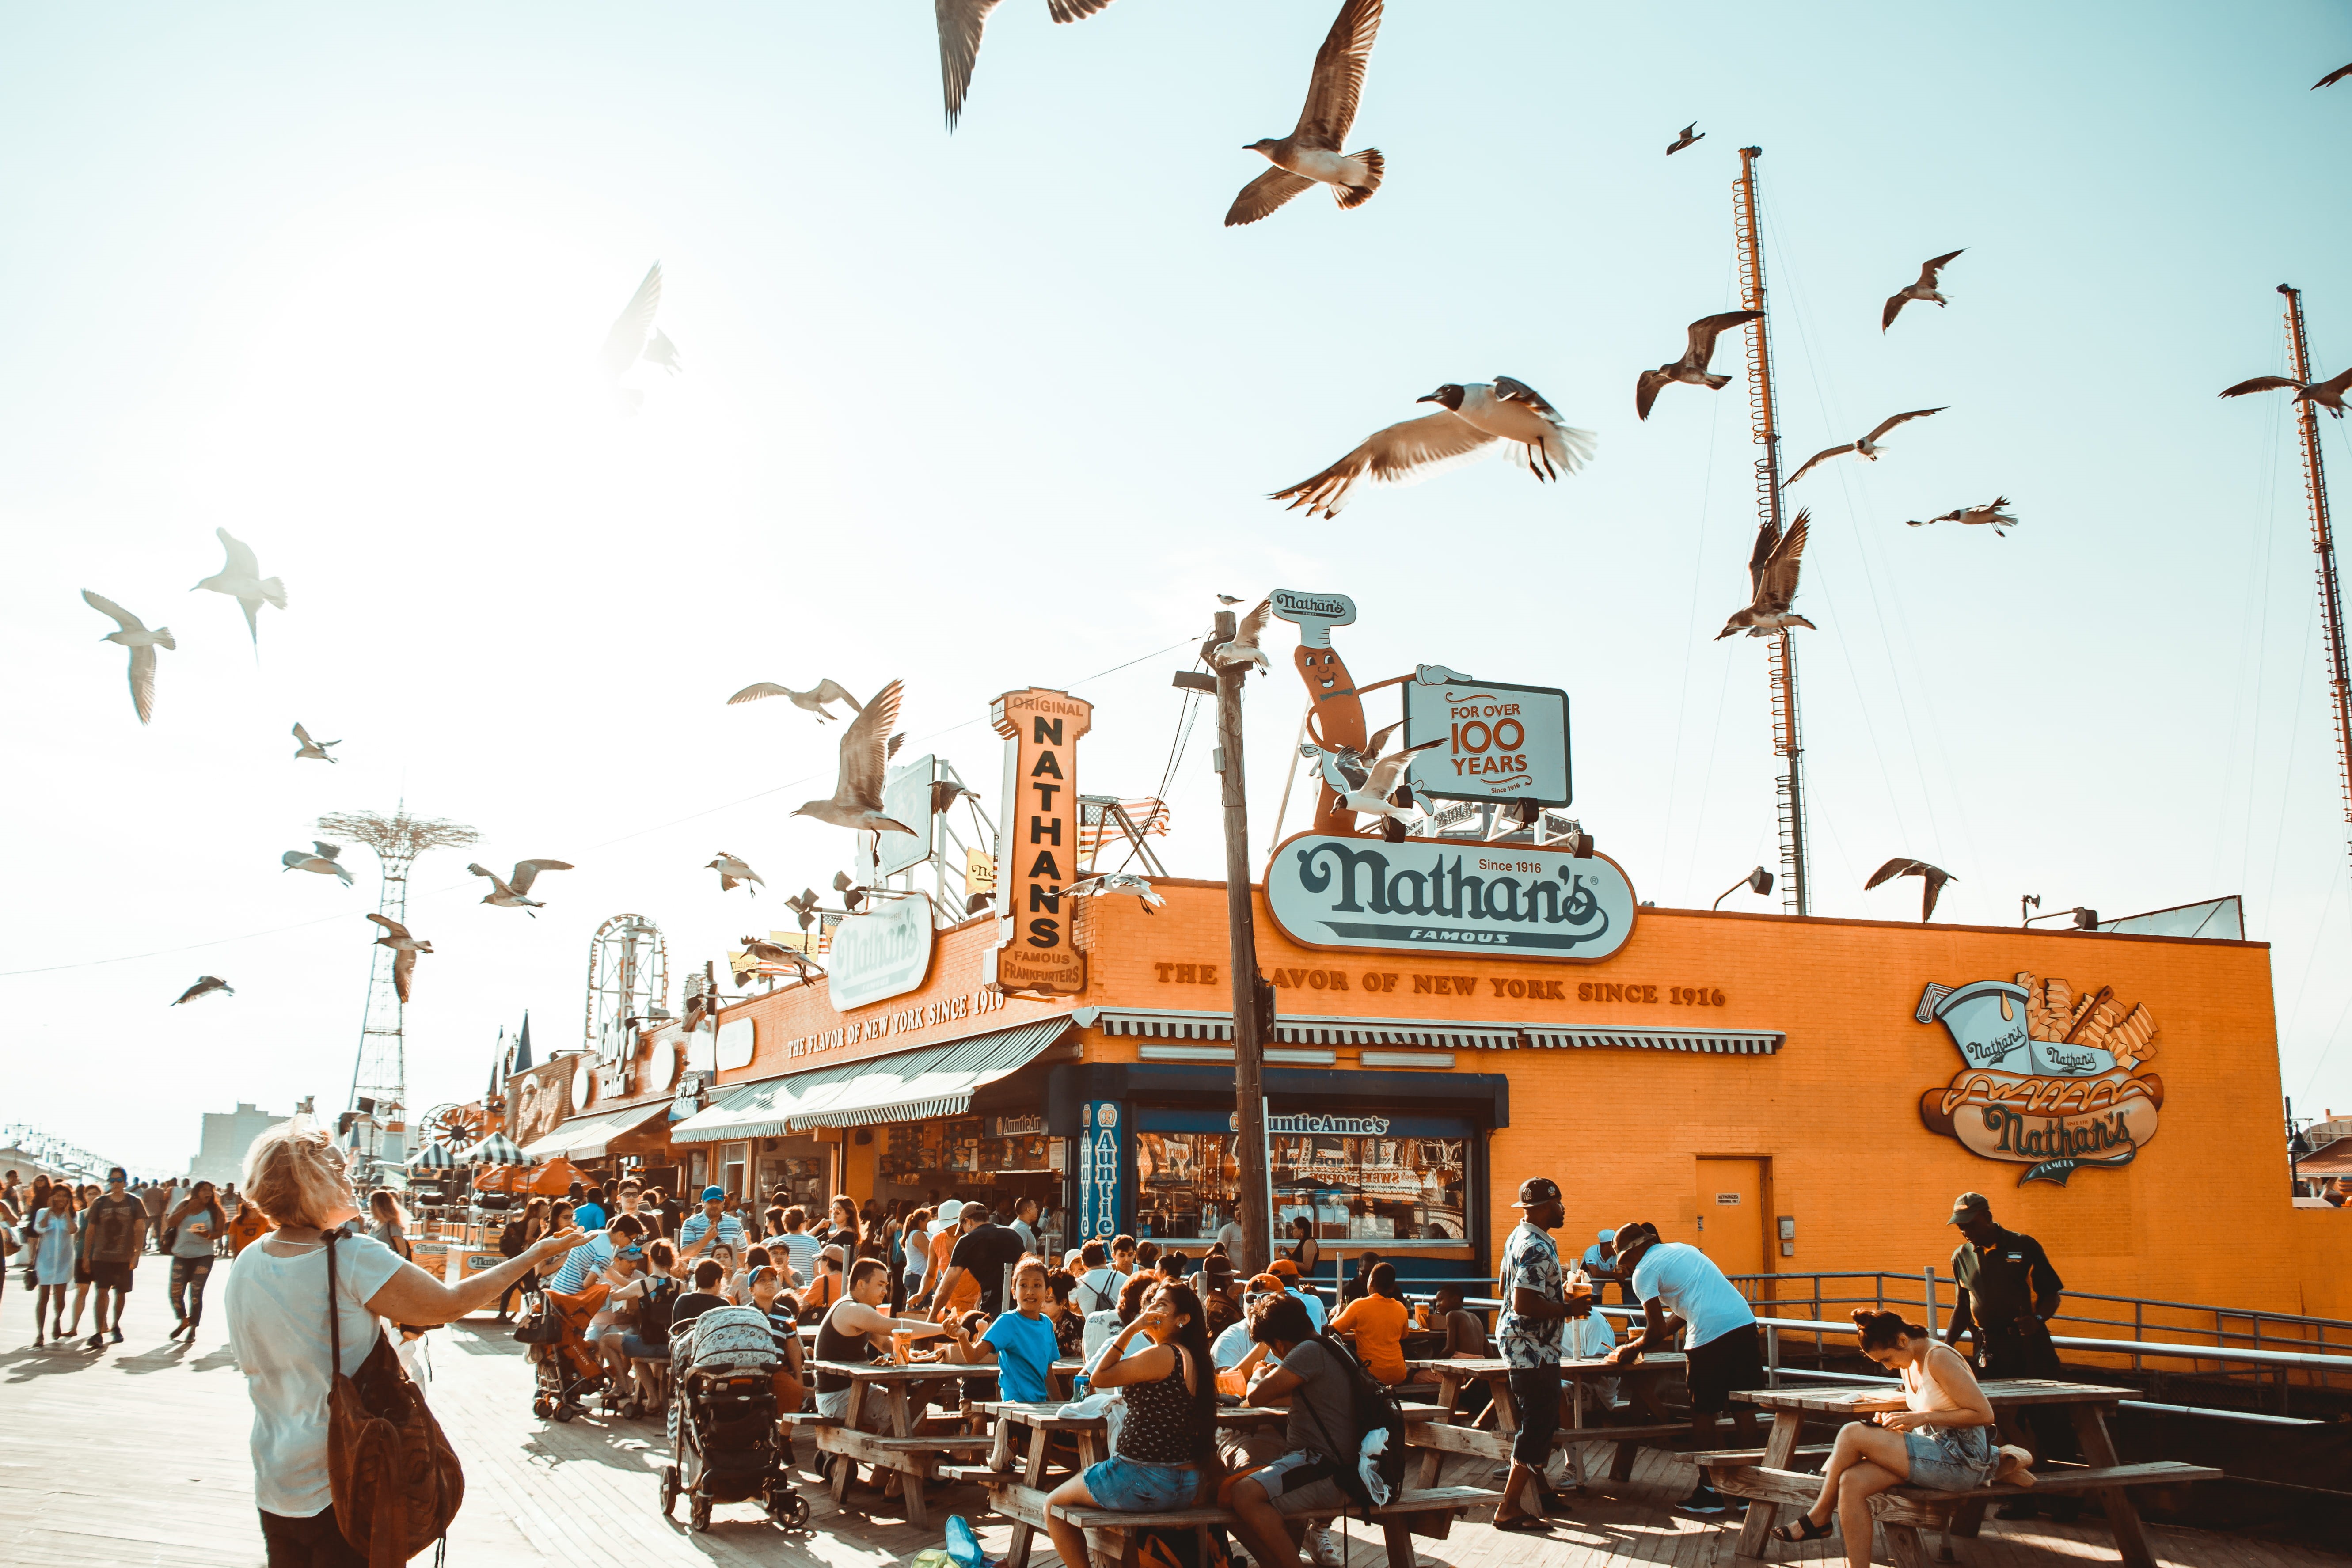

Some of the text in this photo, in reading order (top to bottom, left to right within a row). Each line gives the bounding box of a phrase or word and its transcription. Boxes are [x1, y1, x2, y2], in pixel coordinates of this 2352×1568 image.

[1277, 594, 1345, 613] Nathan's
[1013, 697, 1083, 717] ORIGINAL
[1451, 704, 1520, 719] FOR OVER
[1451, 718, 1524, 755] 100
[1450, 754, 1527, 776] YEARS
[1508, 783, 1520, 792] 1916
[1028, 716, 1063, 948] NATHANS
[1478, 858, 1542, 874] Since 1916
[1296, 841, 1608, 925] Nathan's
[836, 907, 920, 981] Nathan's
[1409, 930, 1510, 944] FAMOUS
[1015, 951, 1070, 964] FAMOUS
[1004, 960, 1079, 983] FRANKFURTERS
[1155, 962, 1725, 1007] THE AVOR OF NEW YORK SINCE 1916
[788, 991, 1004, 1058] THE FLAVOR OF NEW YORK SINCE 1916
[1966, 1025, 2025, 1060] Nathan's
[2046, 1046, 2095, 1067] Nathan's
[675, 1078, 699, 1099] GIFT SHOP
[1268, 1113, 1386, 1133] untieAnne's
[1982, 1105, 2132, 1158] Nathan's
[2040, 1159, 2074, 1173] FAMOUS
[1098, 1132, 1114, 1234] Auntie
